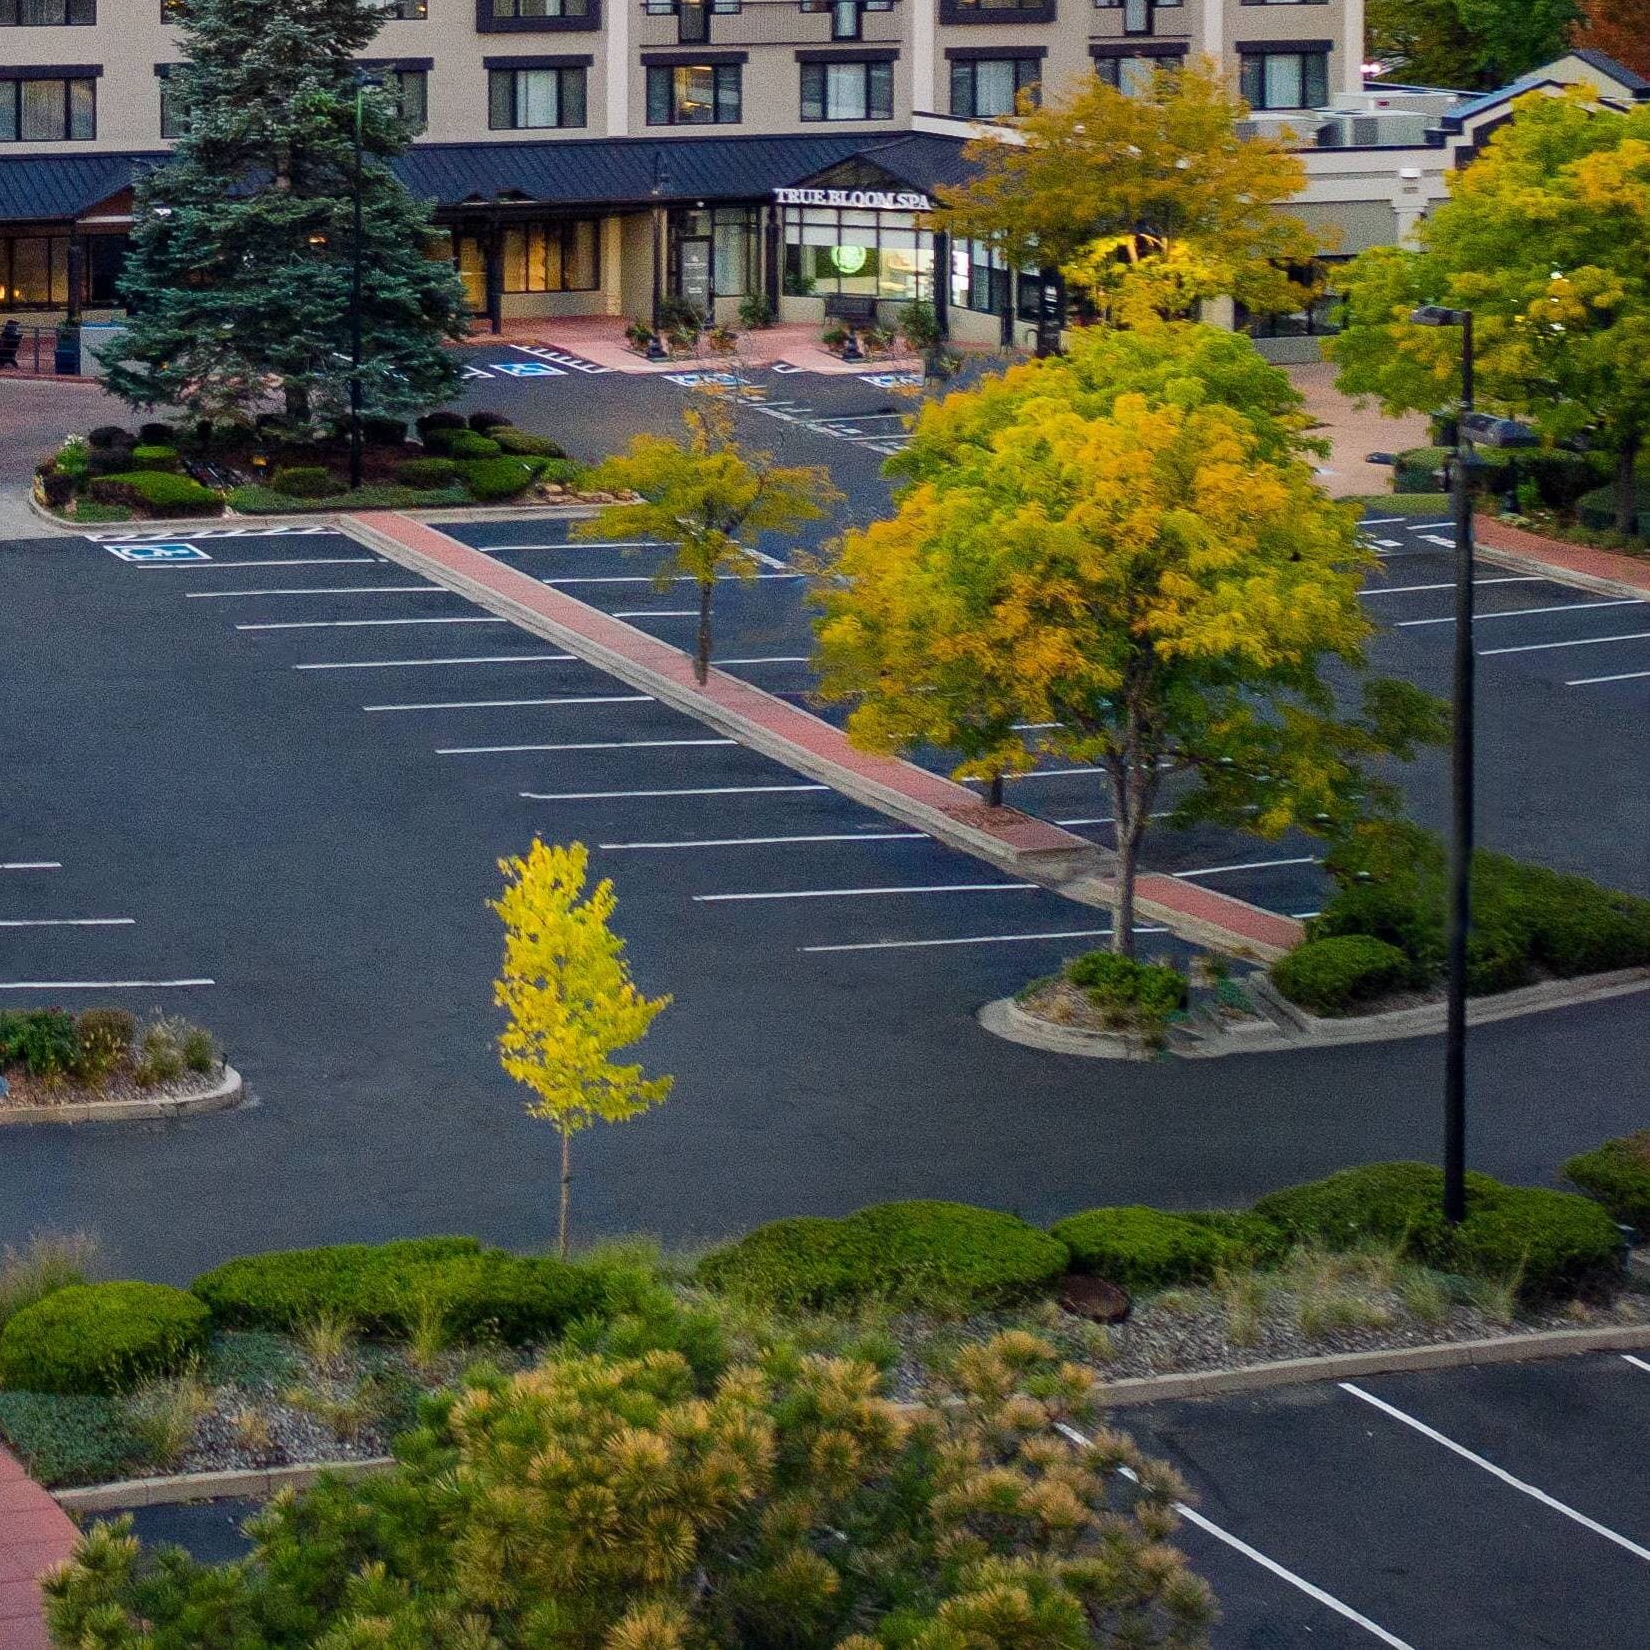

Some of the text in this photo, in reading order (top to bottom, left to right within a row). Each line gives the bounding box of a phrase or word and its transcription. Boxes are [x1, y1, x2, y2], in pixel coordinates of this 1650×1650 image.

[772, 188, 932, 210] TRUE BLOOM SPA
